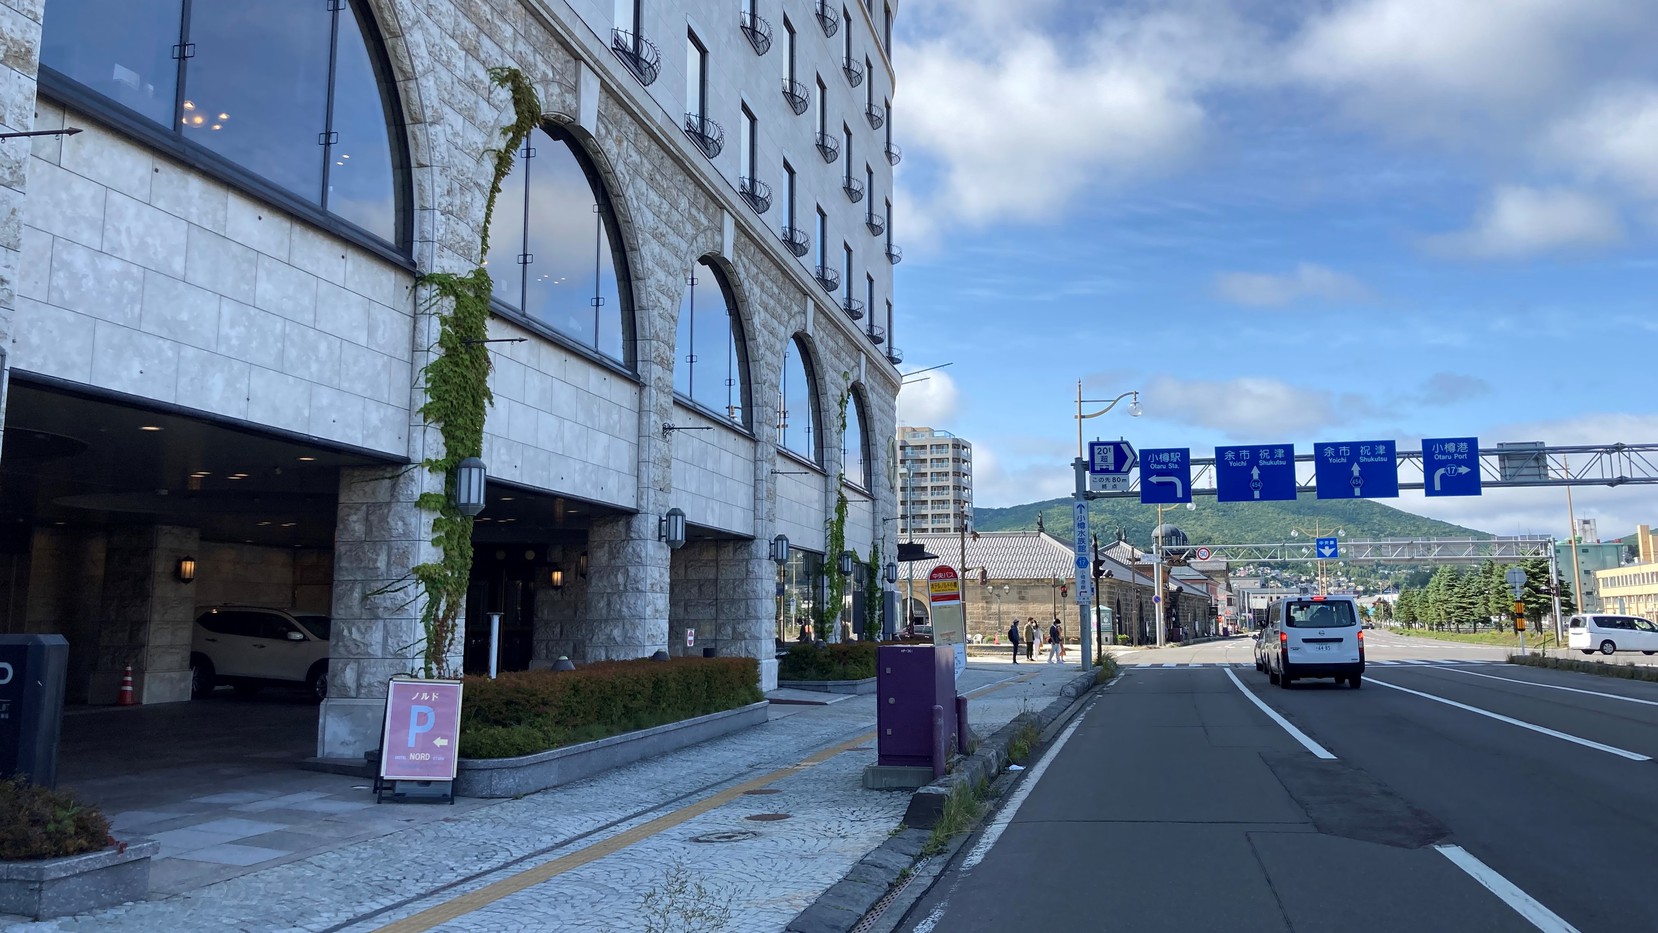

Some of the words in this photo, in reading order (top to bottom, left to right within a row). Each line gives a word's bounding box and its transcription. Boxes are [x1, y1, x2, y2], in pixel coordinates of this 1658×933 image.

[1323, 446, 1351, 457] 余市
[1360, 444, 1386, 456] 祝津
[1432, 442, 1469, 453] 小樽港
[1147, 452, 1182, 463] 小樽駅
[1224, 449, 1250, 460] 余市
[1259, 448, 1285, 460] 祝津
[1446, 466, 1456, 474] 17
[1077, 515, 1087, 553] 小樽水族館
[1199, 550, 1208, 558] 50
[411, 692, 439, 701] ノルド
[407, 704, 435, 748] P
[409, 752, 431, 761] NORD
